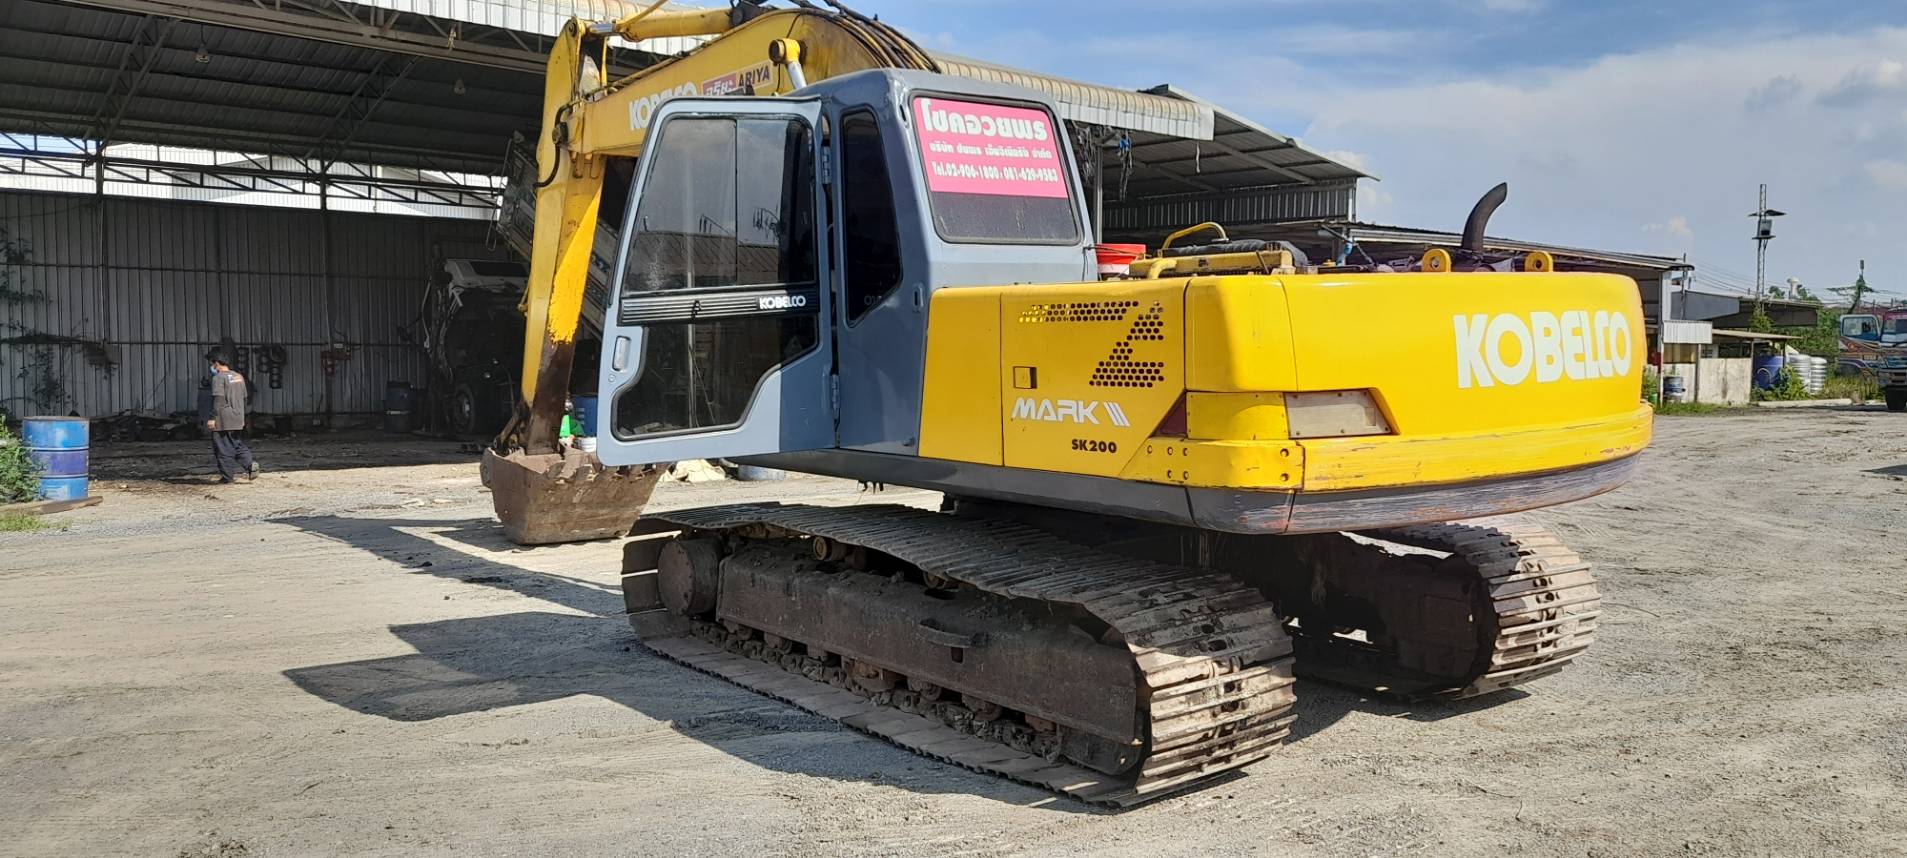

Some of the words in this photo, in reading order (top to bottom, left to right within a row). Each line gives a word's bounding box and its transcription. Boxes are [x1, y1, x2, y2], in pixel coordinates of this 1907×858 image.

[738, 65, 770, 87] ARIYA
[759, 295, 806, 310] KOBELCO
[1453, 310, 1632, 389] KOBELCO
[1011, 397, 1100, 425] MARK
[1071, 439, 1117, 454] SK200
